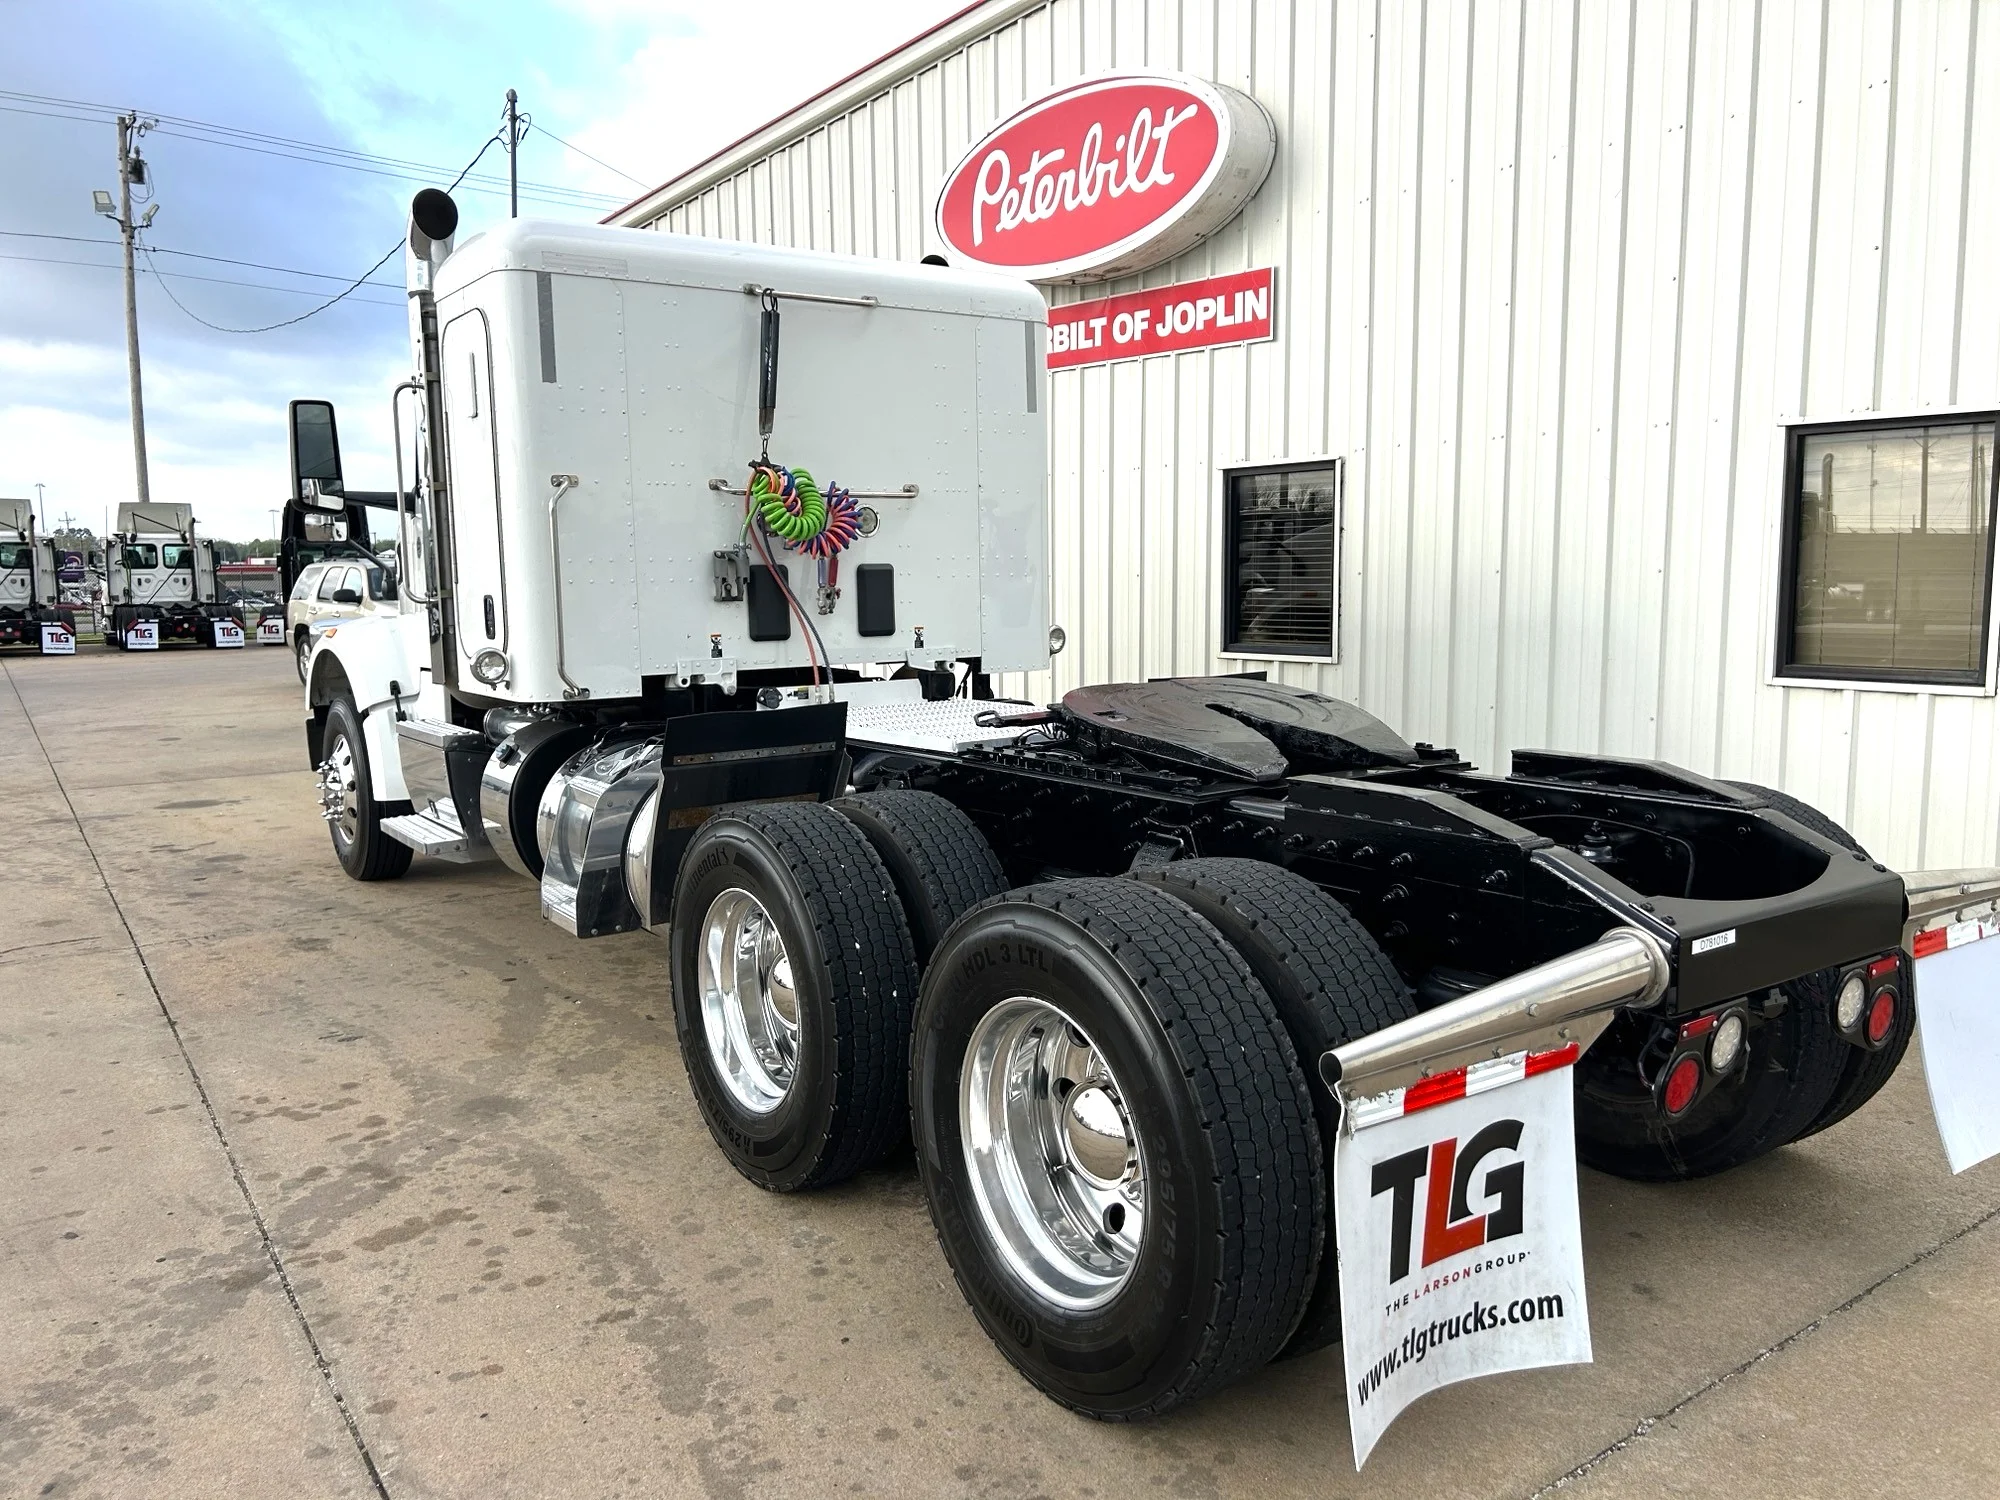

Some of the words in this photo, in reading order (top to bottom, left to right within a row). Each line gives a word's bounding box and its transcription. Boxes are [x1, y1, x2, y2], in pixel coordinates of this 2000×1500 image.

[973, 103, 1199, 247] Peterbilt
[1112, 309, 1150, 344] OF
[1156, 287, 1268, 337] JOPLIN
[47, 632, 70, 643] TLG
[133, 628, 153, 639] TLG
[219, 627, 239, 637] TLG
[261, 625, 280, 634] TLG
[999, 943, 1012, 964] 3
[1017, 943, 1050, 974] LTL
[1371, 1119, 1525, 1286] TLG
[1385, 1293, 1410, 1317] THE
[1357, 1293, 1564, 1407] www.tlgtrucks.com
